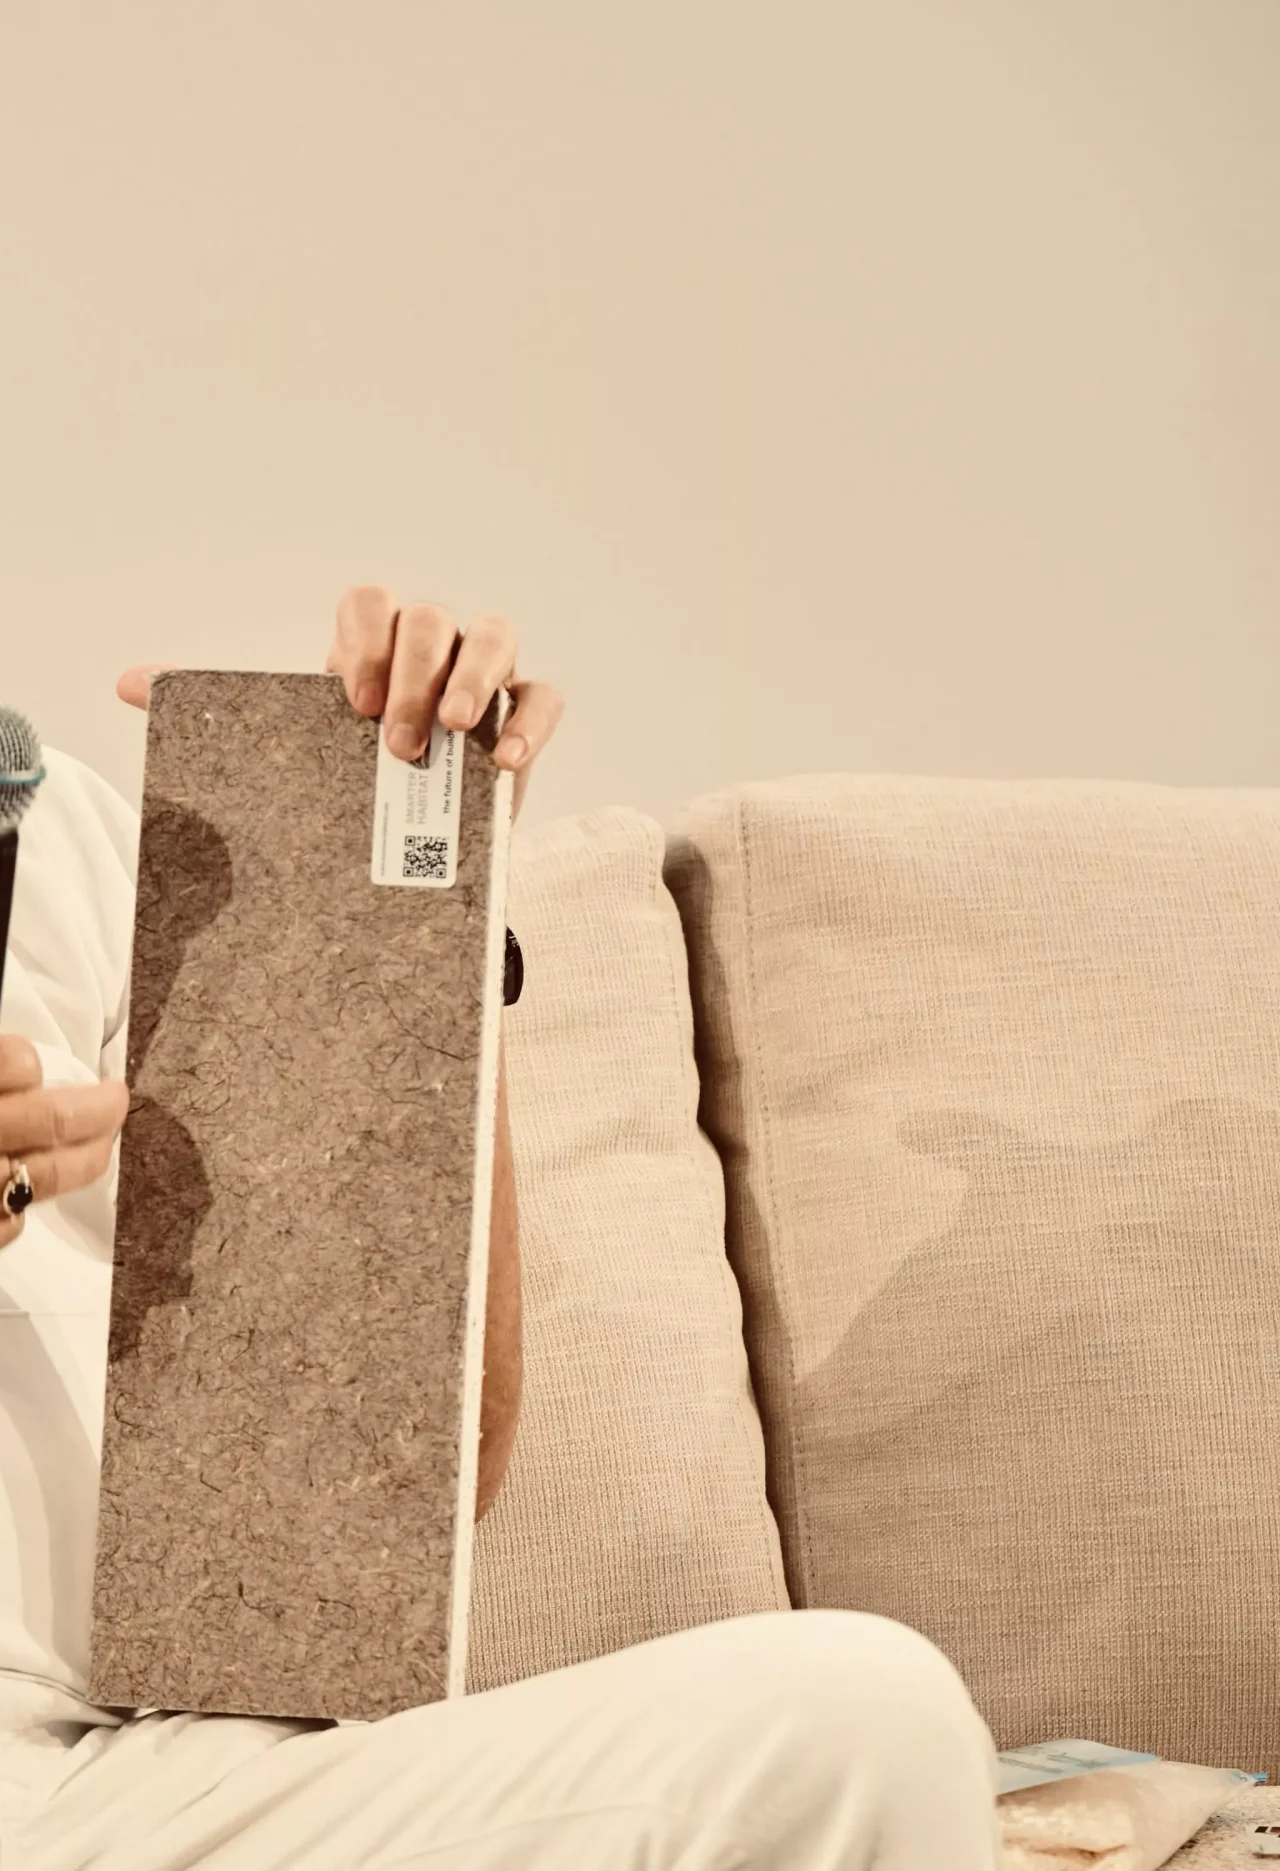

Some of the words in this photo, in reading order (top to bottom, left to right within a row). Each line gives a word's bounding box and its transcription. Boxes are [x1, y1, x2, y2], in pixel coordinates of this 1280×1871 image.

[446, 758, 454, 768] of
[444, 770, 453, 797] future
[404, 772, 417, 825] SMARTER
[416, 774, 429, 825] HABITAT
[443, 799, 451, 814] the
